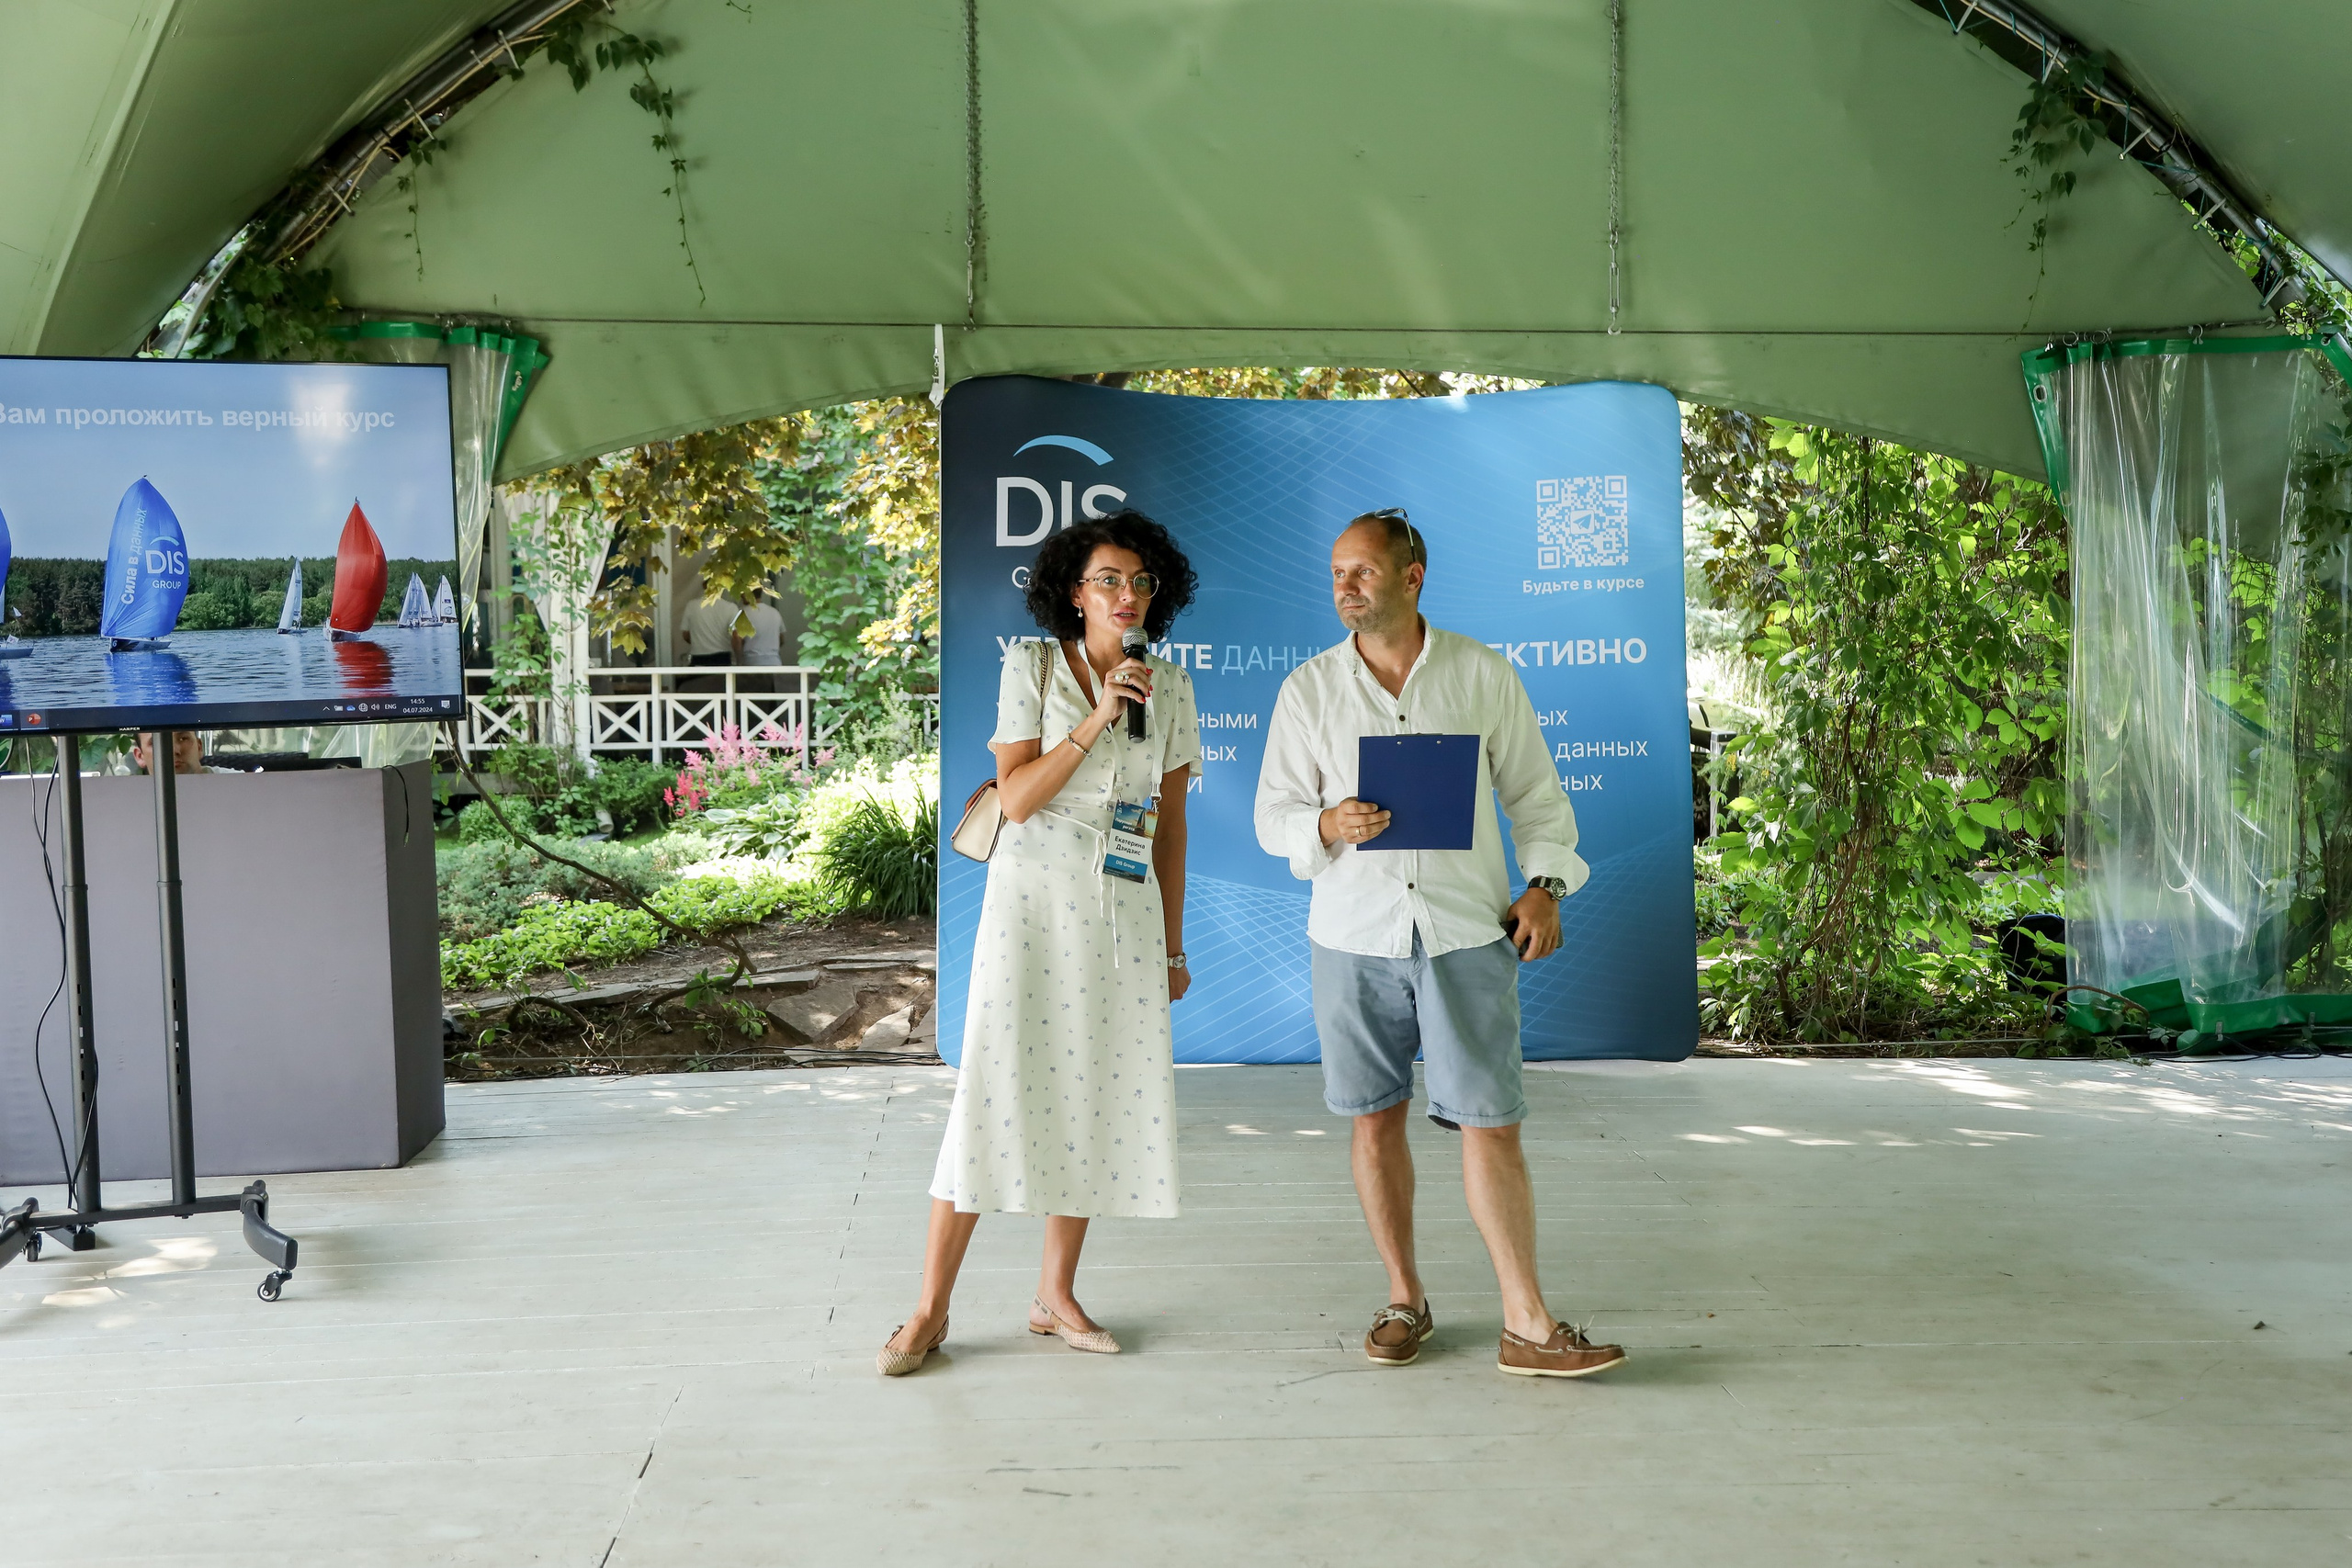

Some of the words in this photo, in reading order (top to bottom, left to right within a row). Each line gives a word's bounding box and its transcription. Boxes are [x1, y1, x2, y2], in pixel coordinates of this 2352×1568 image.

[55, 408, 214, 429] проложить
[222, 406, 327, 432] верный
[336, 412, 395, 433] курс
[145, 549, 185, 575] DIS
[121, 568, 138, 604] Сила
[152, 580, 182, 590] GROUP
[1522, 580, 1579, 595] Будьте
[1583, 580, 1593, 590] в
[1597, 578, 1645, 592] курсе
[1537, 710, 1569, 727] ых
[1555, 740, 1649, 762] данных
[1114, 835, 1145, 850] Екатерина
